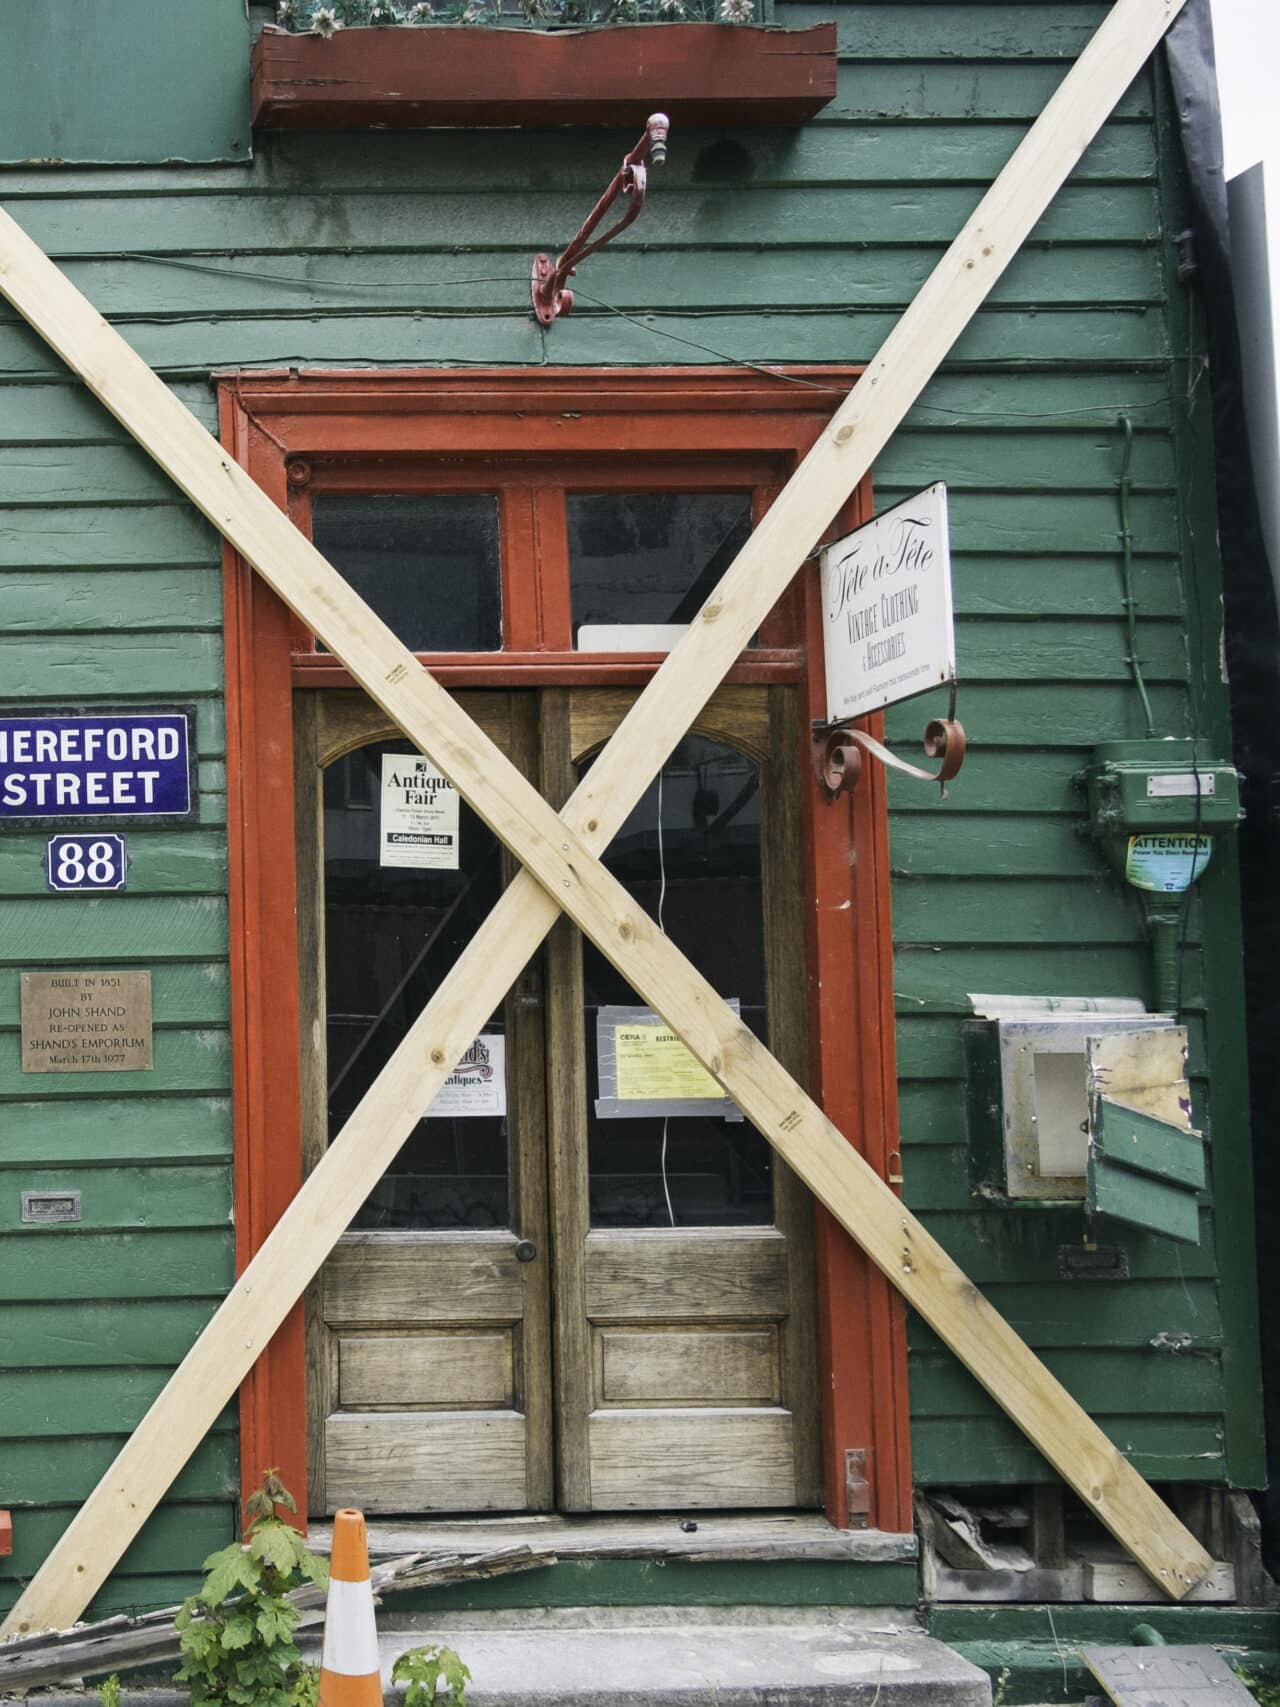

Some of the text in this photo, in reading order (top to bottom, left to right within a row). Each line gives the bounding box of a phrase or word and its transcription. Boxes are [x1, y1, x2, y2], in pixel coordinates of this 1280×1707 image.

[1, 771, 160, 807] STREET
[405, 790, 438, 805] Fair
[392, 834, 448, 844] Caledonian Hall
[1134, 838, 1208, 848] ATTENTION
[57, 842, 115, 884] 88
[50, 978, 78, 988] BUILT
[85, 978, 96, 988] IN
[80, 992, 94, 1002] BY
[48, 1006, 126, 1020] JOHN SHAND
[49, 1024, 125, 1033] RE-OPENED AS
[82, 1038, 145, 1048] EMPORIUM
[104, 1054, 126, 1064] 1977
